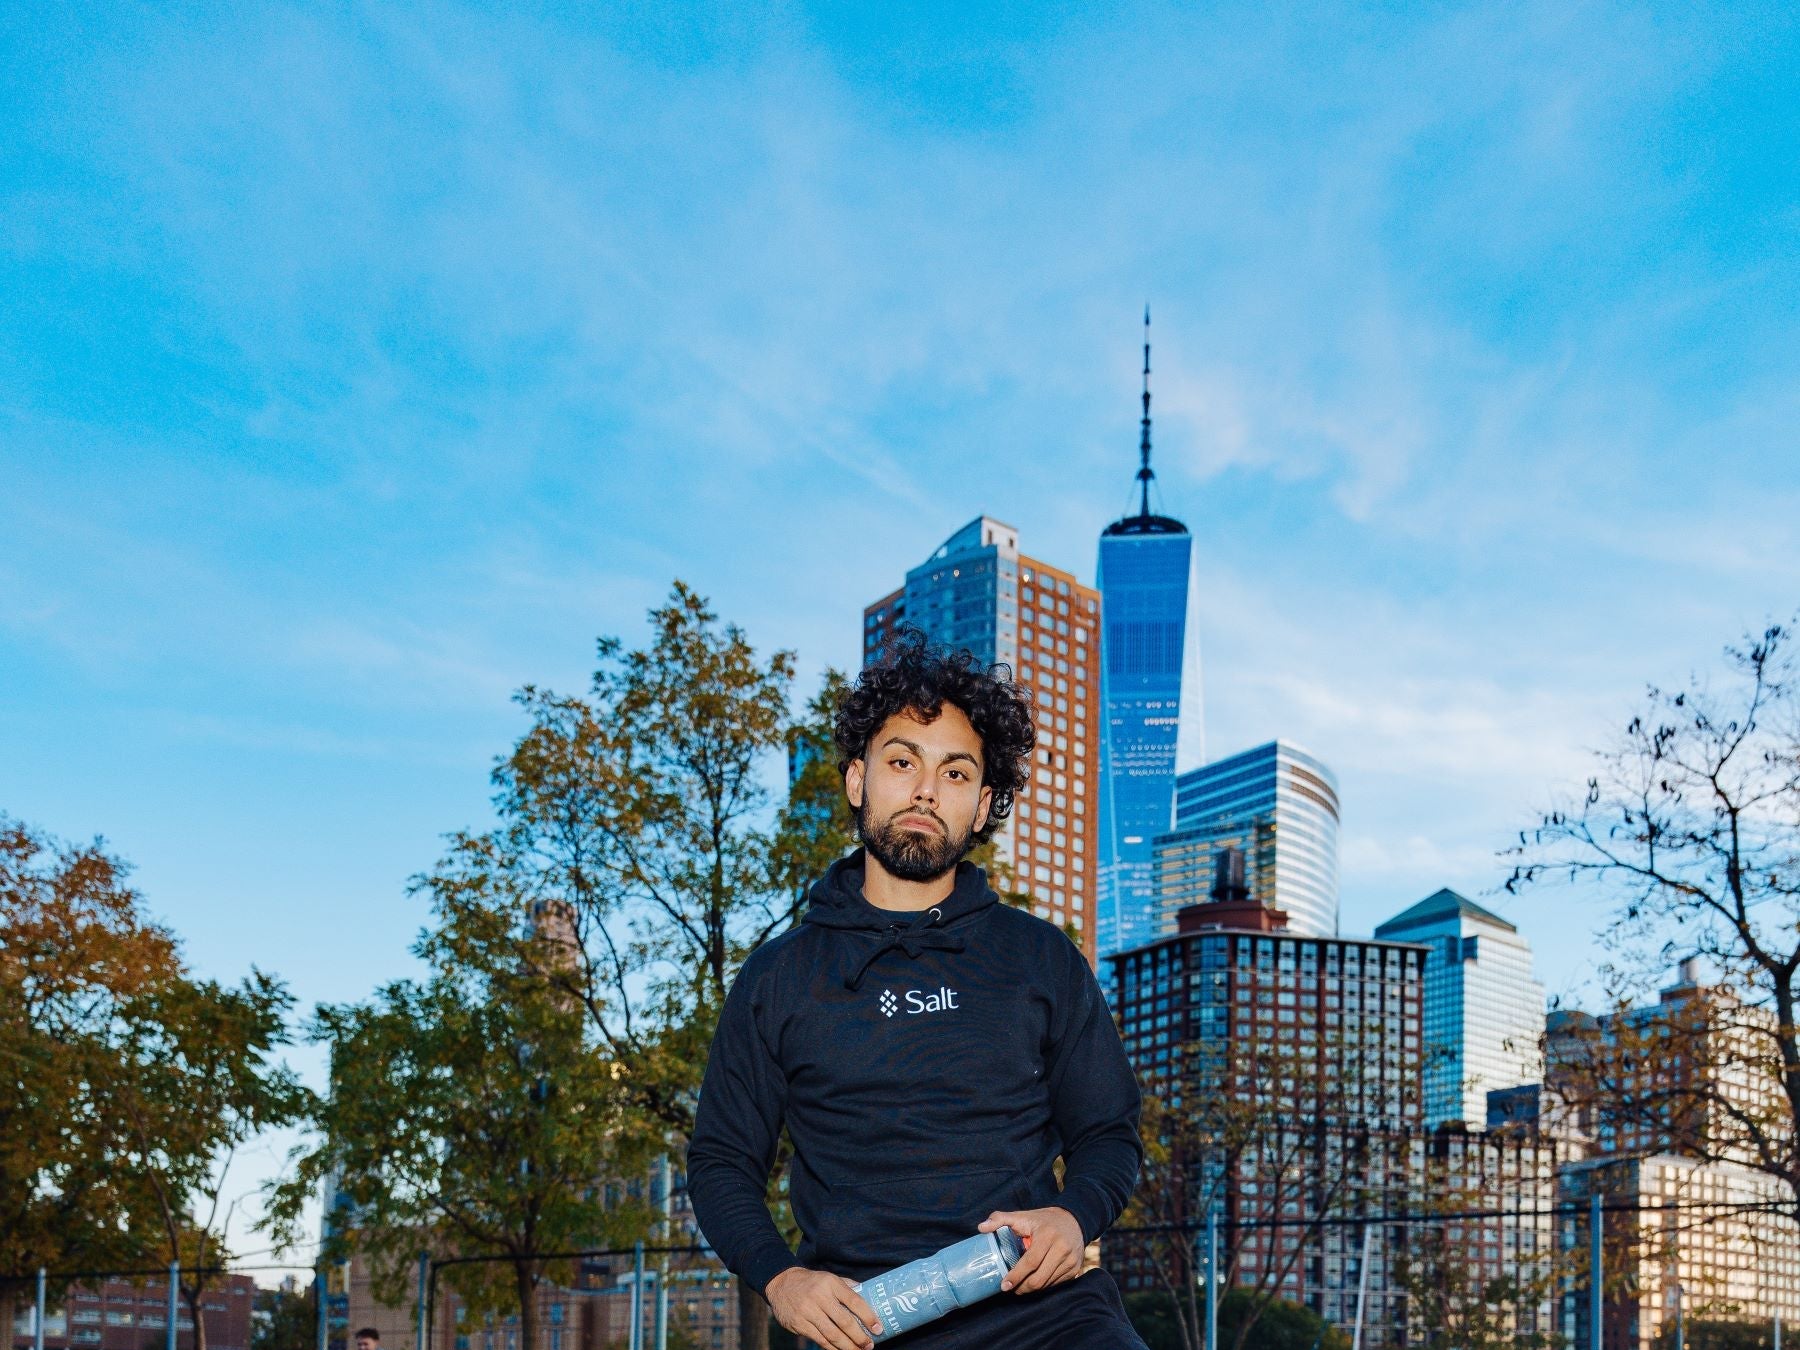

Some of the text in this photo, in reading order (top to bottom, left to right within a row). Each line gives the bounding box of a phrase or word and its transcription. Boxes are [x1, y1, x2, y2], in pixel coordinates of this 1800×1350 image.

[905, 987, 959, 1014] Salt
[875, 1282, 887, 1297] FIT
[880, 1299, 893, 1315] TO
